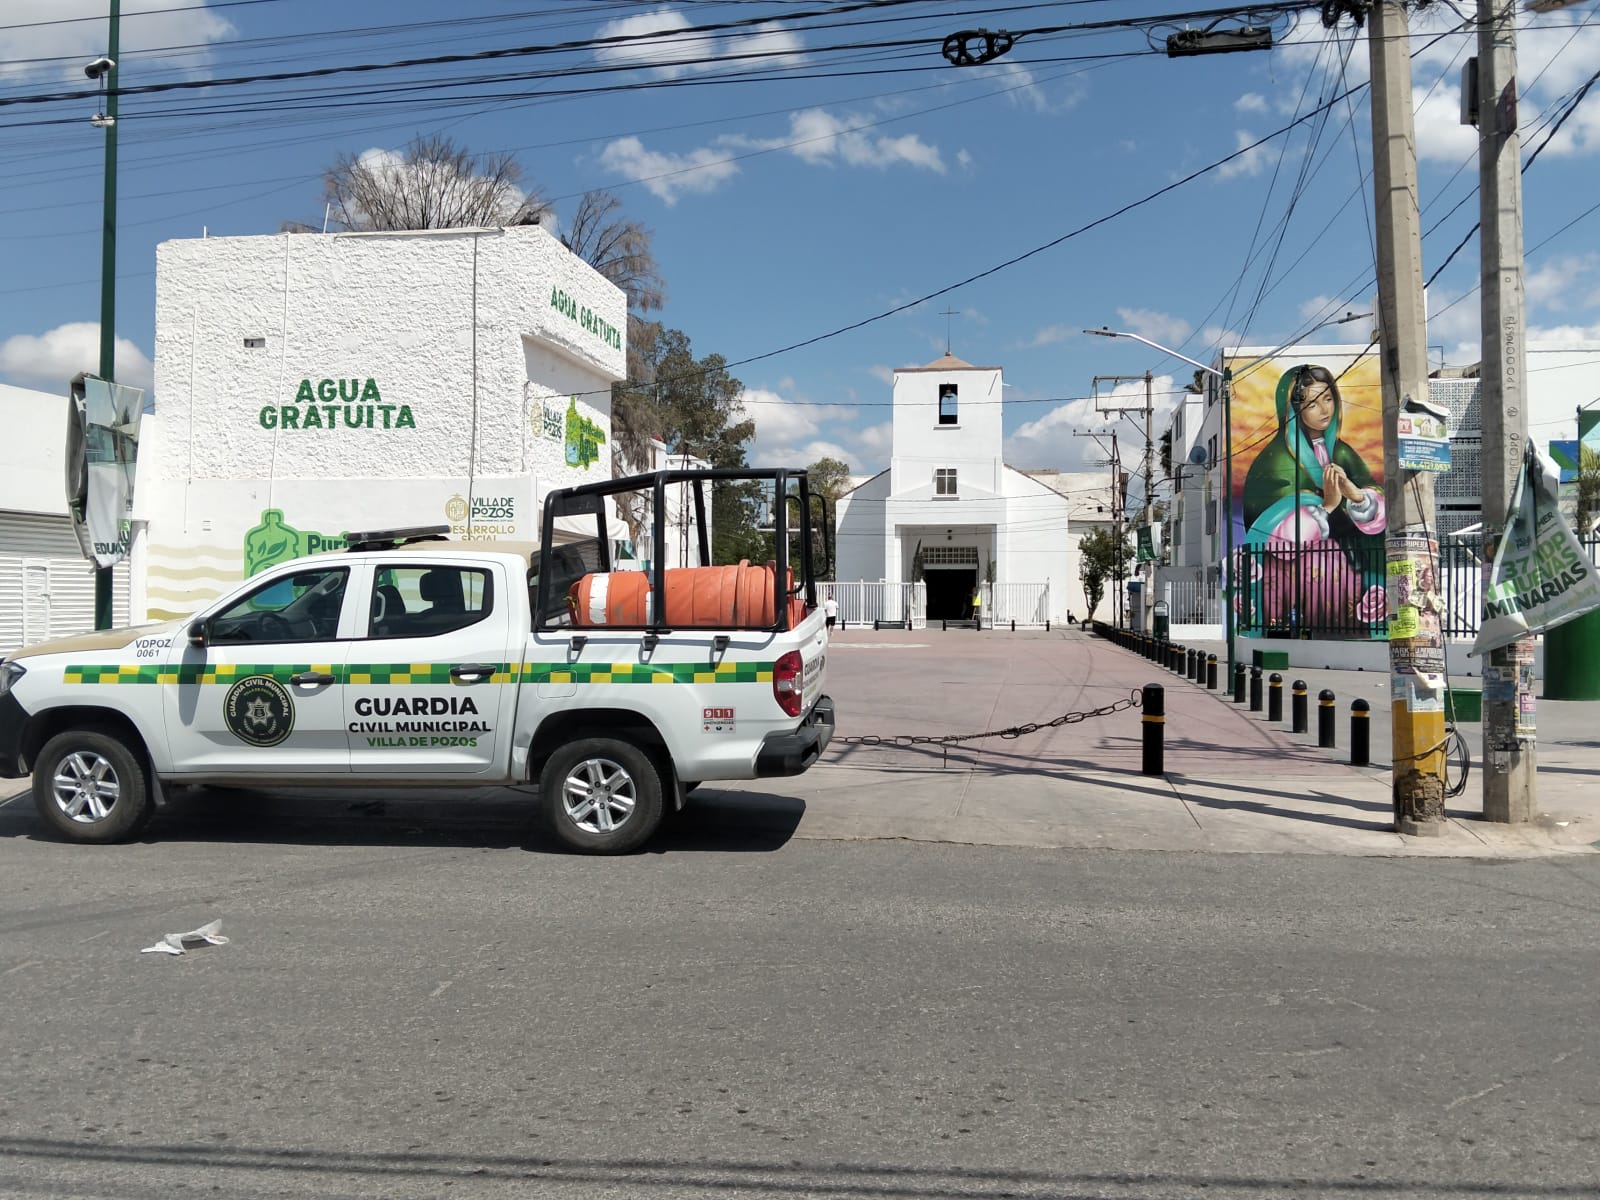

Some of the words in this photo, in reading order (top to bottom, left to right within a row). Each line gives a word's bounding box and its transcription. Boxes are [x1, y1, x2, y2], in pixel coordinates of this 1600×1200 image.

[551, 285, 577, 321] AGUA
[580, 305, 621, 351] GRATUITA
[295, 378, 381, 403] AGUA
[259, 405, 416, 430] GRATUITA
[472, 497, 499, 507] VILLA
[500, 497, 514, 507] DE
[471, 507, 514, 518] POZOS
[449, 525, 515, 534] ESARROLLO
[1501, 556, 1530, 579] 37
[1481, 560, 1588, 621] UMINARIAS
[135, 639, 172, 649] VDPOZ
[136, 650, 160, 658] 0061
[229, 685, 246, 717] GUARDIA
[244, 679, 265, 687] CIVIL
[264, 680, 289, 718] MUNICIPAL
[354, 697, 479, 716] GUARDIA
[704, 709, 733, 718] 911
[349, 721, 393, 733] CIVIL
[395, 720, 492, 733] MUNICIPAL
[366, 737, 407, 747] VILLA
[409, 737, 428, 747] DE
[430, 736, 478, 747] POZOS
